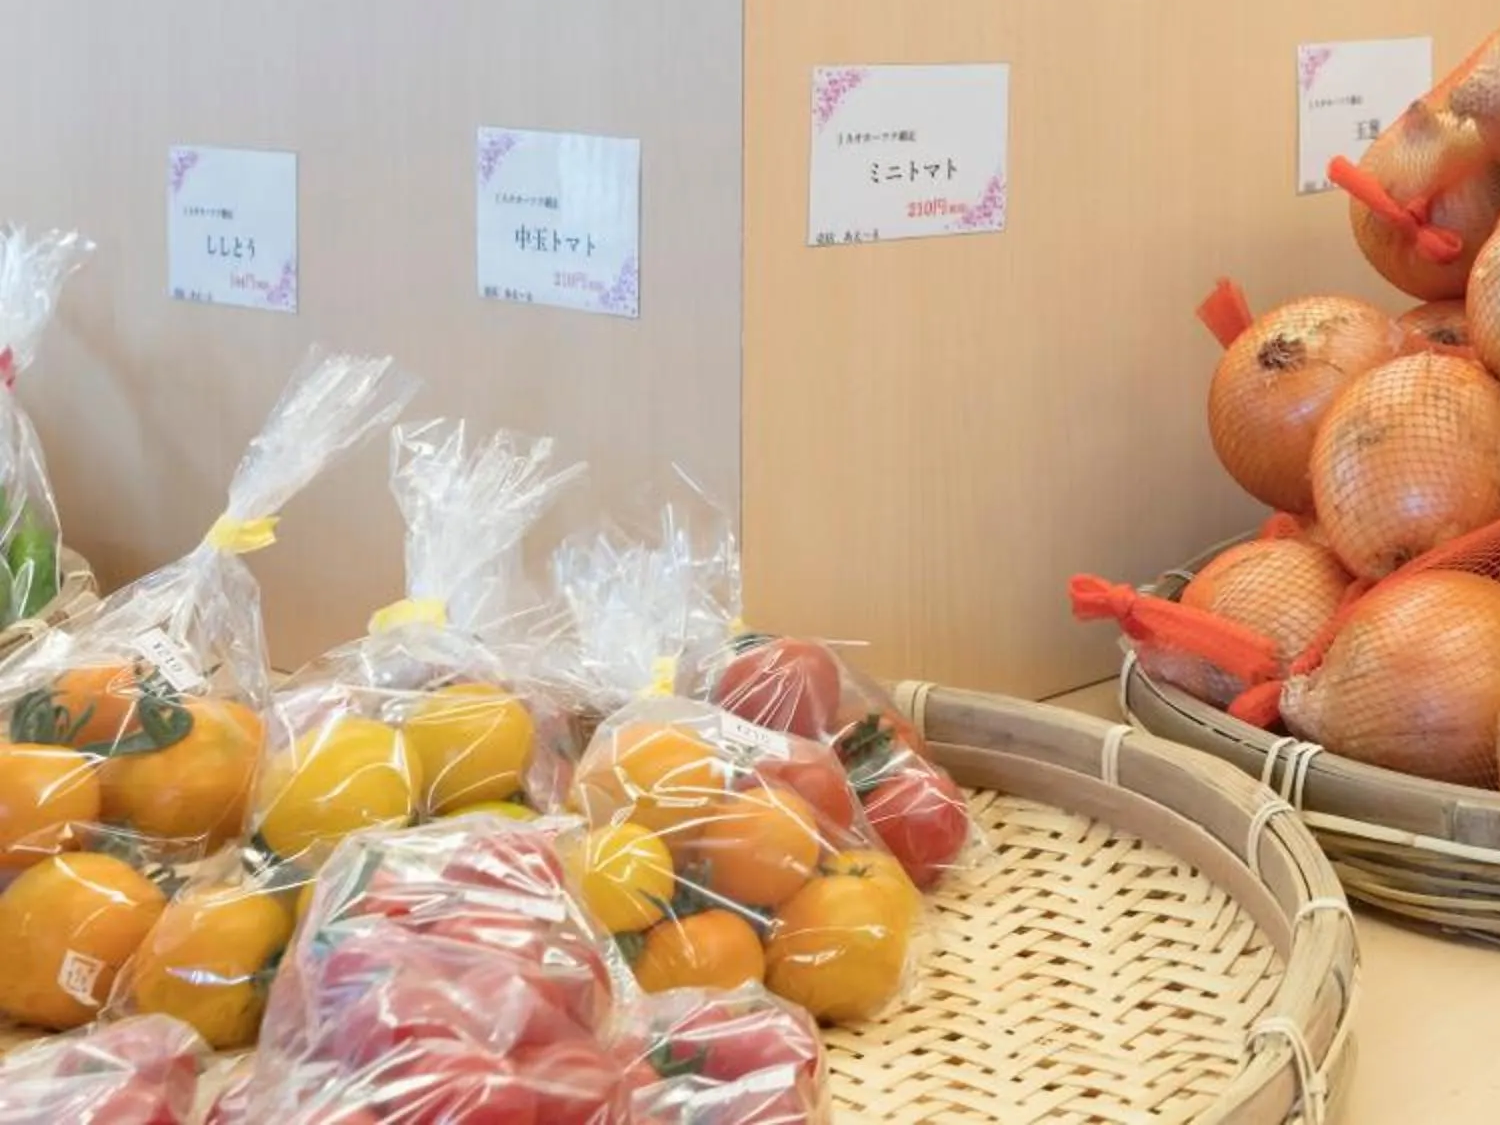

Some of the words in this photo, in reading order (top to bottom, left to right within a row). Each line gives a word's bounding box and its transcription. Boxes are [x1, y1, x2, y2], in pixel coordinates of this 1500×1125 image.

[871, 158, 957, 183] ミニトマト
[207, 235, 255, 259] ししとう
[515, 224, 595, 256] 中玉トマト
